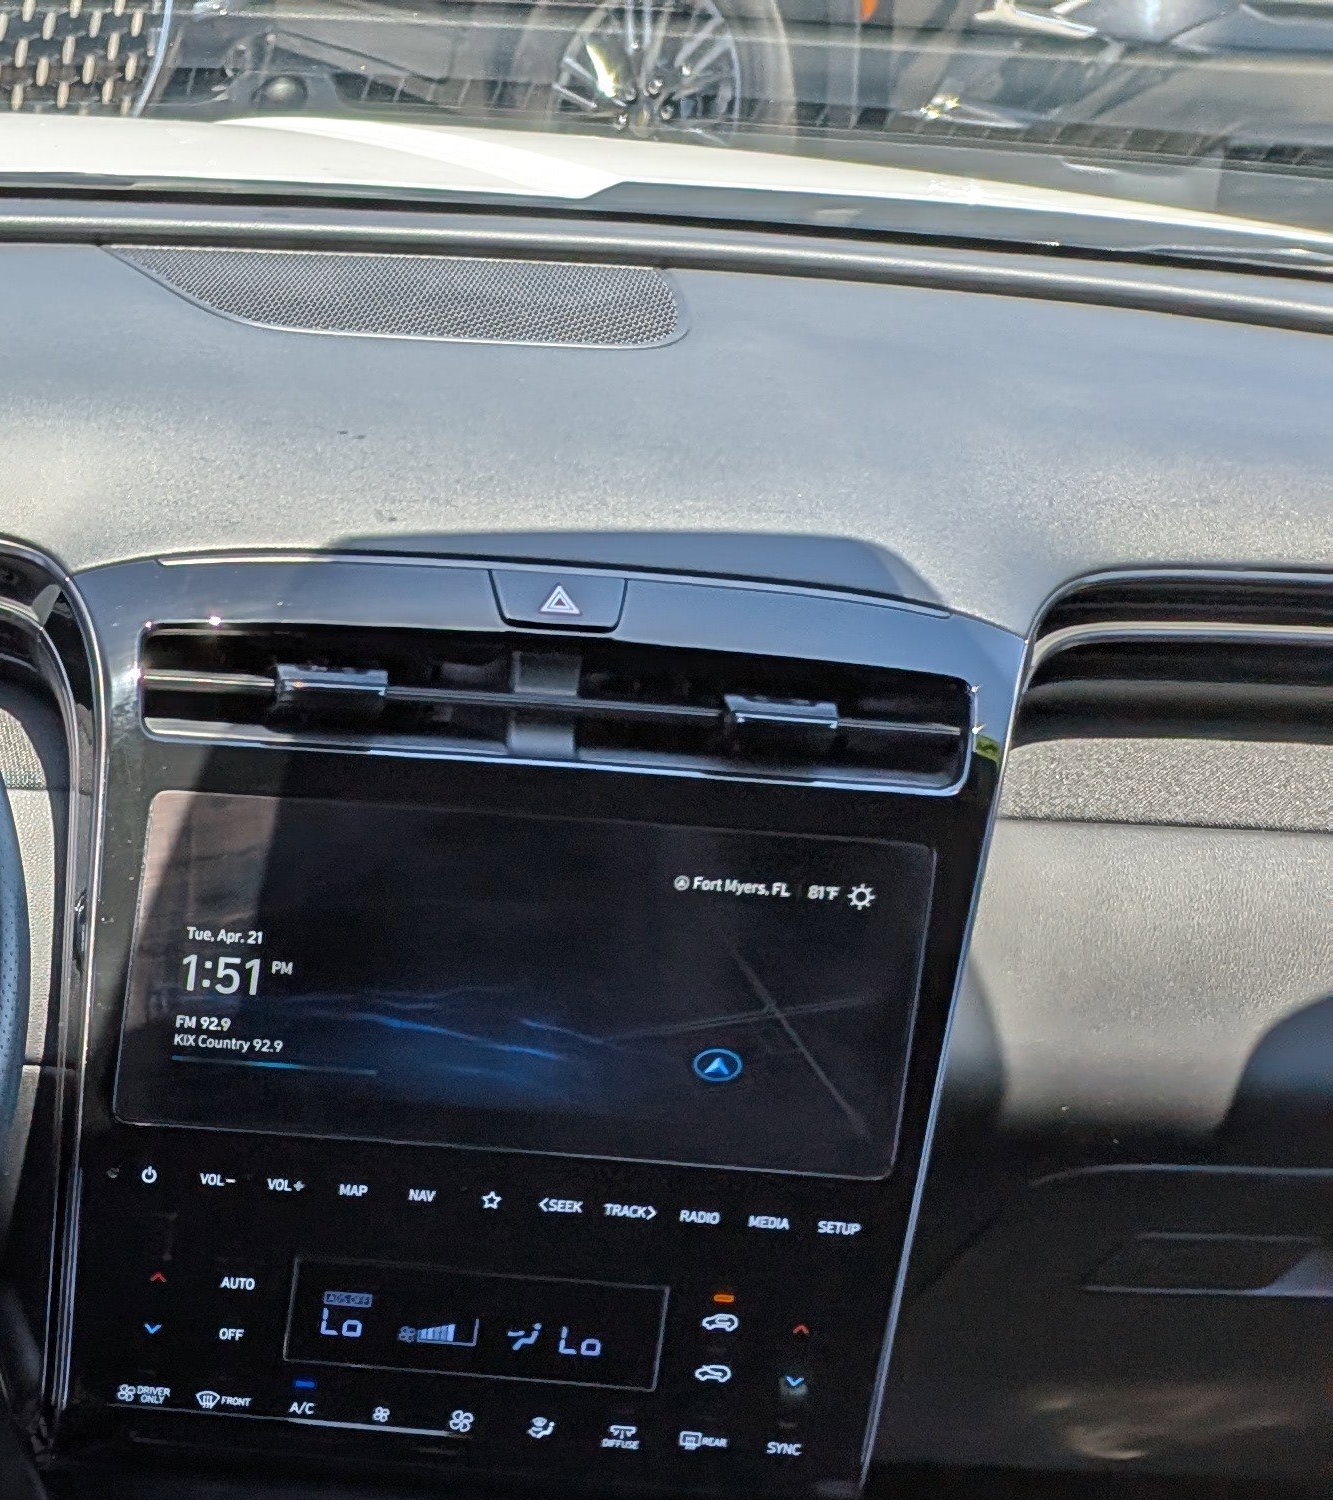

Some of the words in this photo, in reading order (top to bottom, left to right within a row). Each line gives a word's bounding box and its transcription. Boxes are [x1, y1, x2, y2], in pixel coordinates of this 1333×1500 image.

[692, 876, 723, 892] Fort
[724, 879, 770, 897] Myers,
[771, 882, 792, 898] FL
[186, 926, 215, 943] Tue,
[217, 929, 245, 945] Apr.
[246, 931, 263, 945] 21
[182, 954, 261, 996] 1:51
[271, 961, 294, 975] PM
[175, 1014, 196, 1029] FM
[199, 1016, 231, 1032] 92.9
[173, 1033, 196, 1047] KIX
[197, 1034, 251, 1053] Country
[252, 1038, 283, 1053] 92.9
[338, 1183, 368, 1198] MAP
[408, 1188, 436, 1203] NAV
[679, 1209, 721, 1225] RADIO
[748, 1215, 790, 1230] MEDIA
[817, 1220, 862, 1236] SETUP
[220, 1276, 255, 1291] AUTO
[219, 1327, 245, 1342] OFF
[136, 1385, 171, 1397] DRIVER
[140, 1394, 165, 1405] ONLY
[221, 1395, 252, 1408] FRONT
[289, 1402, 315, 1415] A/C
[600, 1438, 640, 1450] DIFFUSE
[702, 1437, 728, 1448] REAR
[766, 1441, 802, 1456] SYNC
